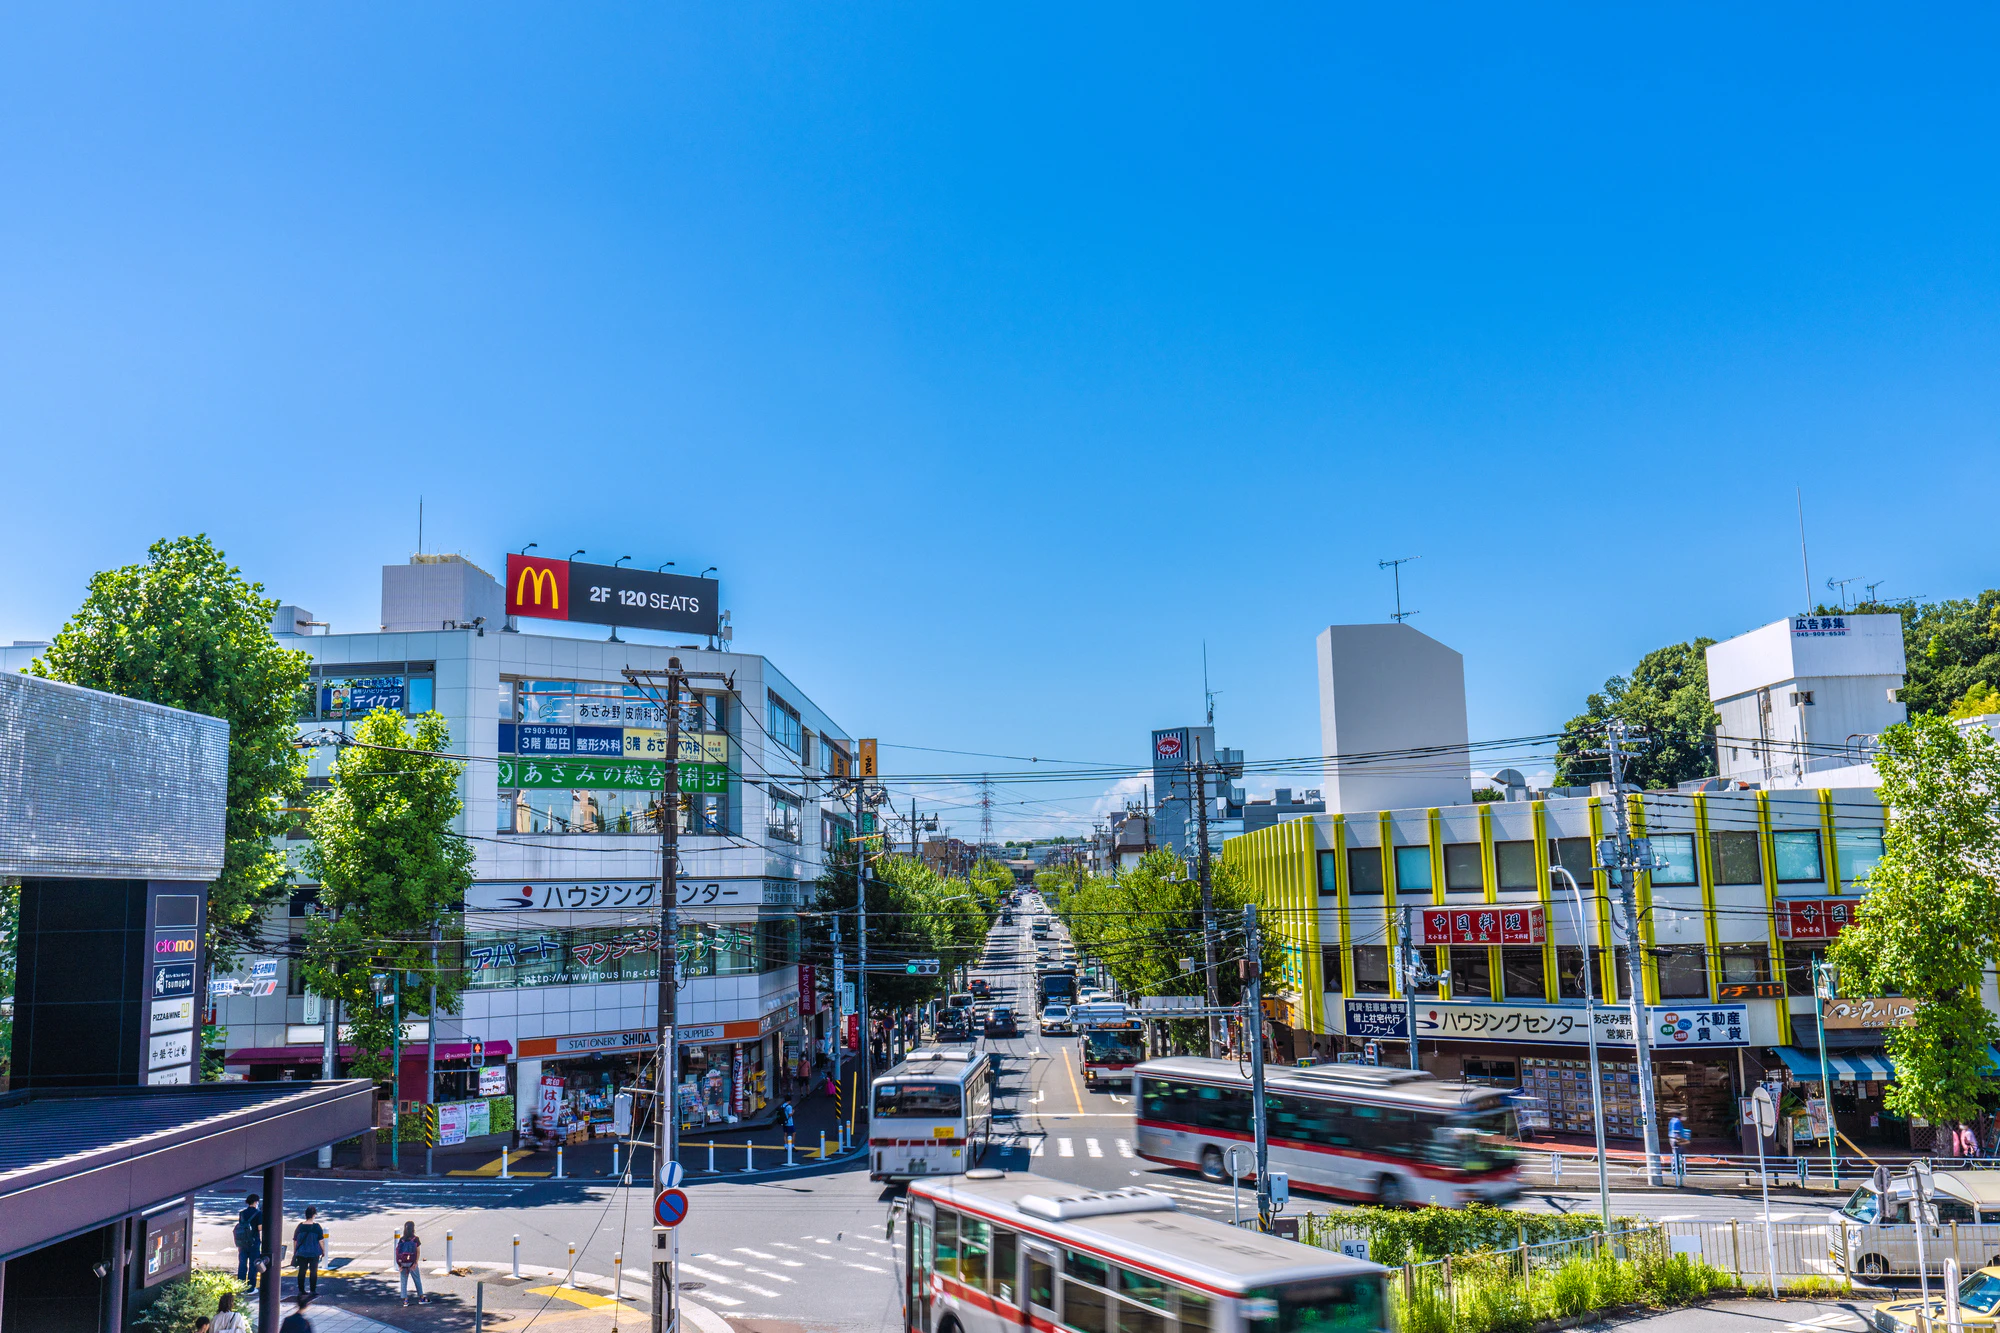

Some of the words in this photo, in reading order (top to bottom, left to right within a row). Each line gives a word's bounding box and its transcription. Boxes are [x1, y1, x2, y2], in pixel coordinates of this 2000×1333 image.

[590, 586, 611, 602] 2F
[618, 590, 647, 607] 120
[649, 593, 699, 613] SEATS
[1795, 617, 1845, 630] 広告募集
[579, 703, 621, 719] あざみ野
[532, 727, 568, 735] 903-0102
[522, 737, 541, 750] 3階
[545, 737, 571, 750] 脇田
[576, 738, 621, 752] 整形外科
[625, 737, 641, 752] 3階
[706, 772, 725, 787] 3F
[543, 883, 739, 908] ハウジングンター
[1433, 913, 1522, 933] 中国料理
[156, 939, 195, 953] etomo
[470, 935, 560, 973] アパート
[802, 973, 811, 1012] さくら薬局
[153, 1011, 181, 1021] PIZZA&WINE
[1353, 1013, 1401, 1024] 借上社宅代行
[1442, 1012, 1588, 1035] ハウジングセンター
[1696, 1011, 1741, 1026] 不動産
[1360, 1023, 1396, 1035] リフォーム
[1697, 1026, 1742, 1041] 賃貸
[569, 1037, 617, 1049] STATIONERY
[622, 1032, 651, 1046] SHIDA
[683, 1028, 714, 1039] SUPPLIES
[542, 1089, 558, 1128] はんこ
